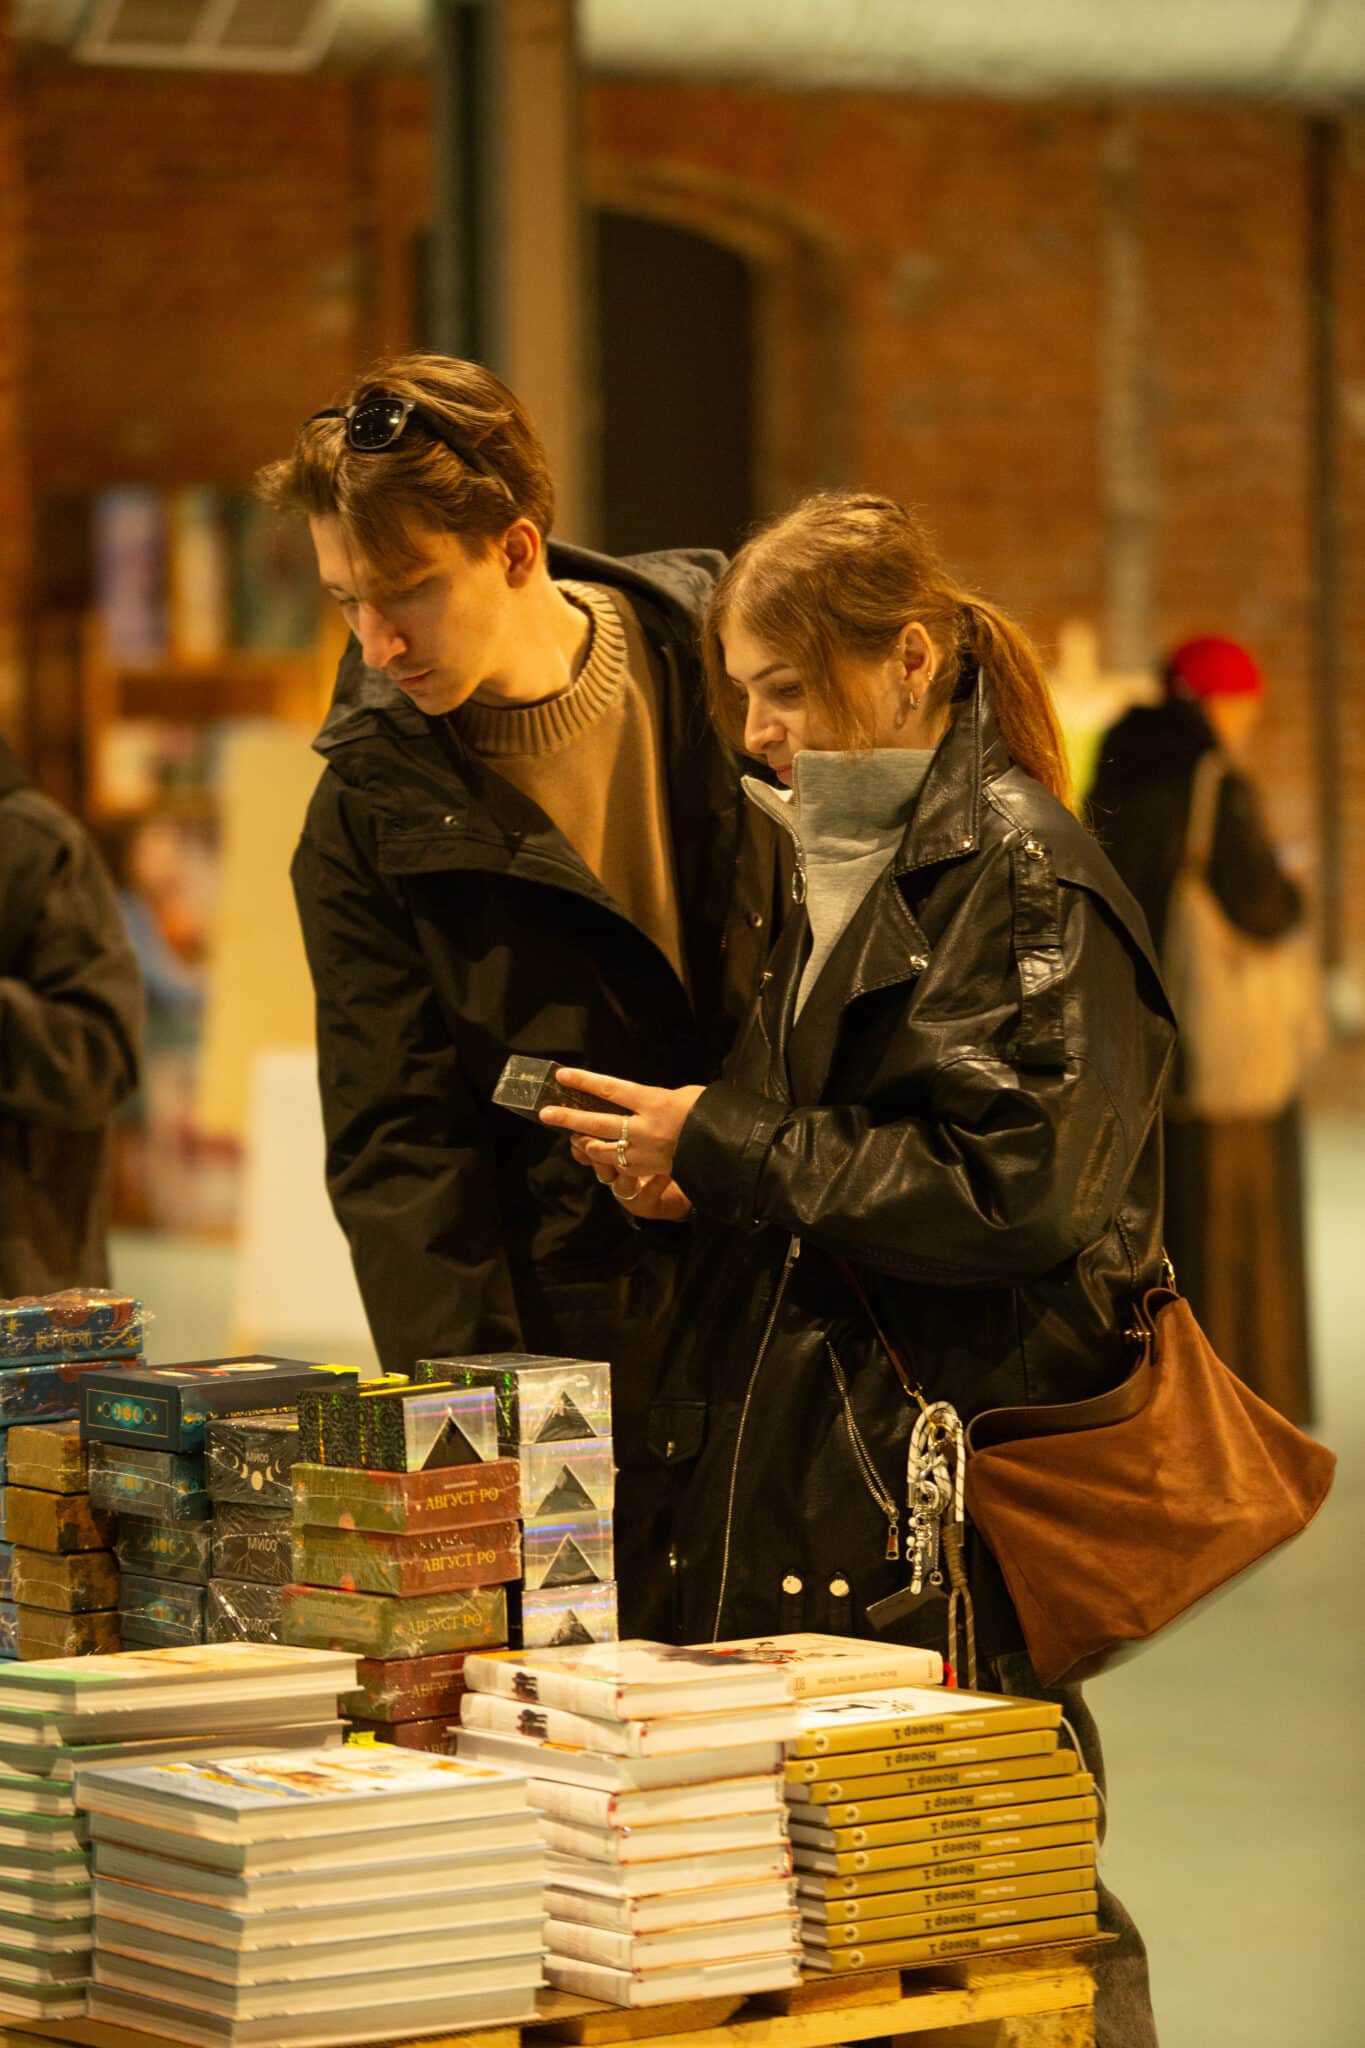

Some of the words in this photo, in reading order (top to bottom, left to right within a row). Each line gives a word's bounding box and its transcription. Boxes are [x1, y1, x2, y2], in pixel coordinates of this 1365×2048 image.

[424, 1490, 477, 1510] АВГУСТ
[479, 1487, 500, 1503] РО
[422, 1552, 473, 1573] АВГУСТ
[476, 1550, 497, 1565] РО
[407, 1616, 459, 1635] АВГУСТ
